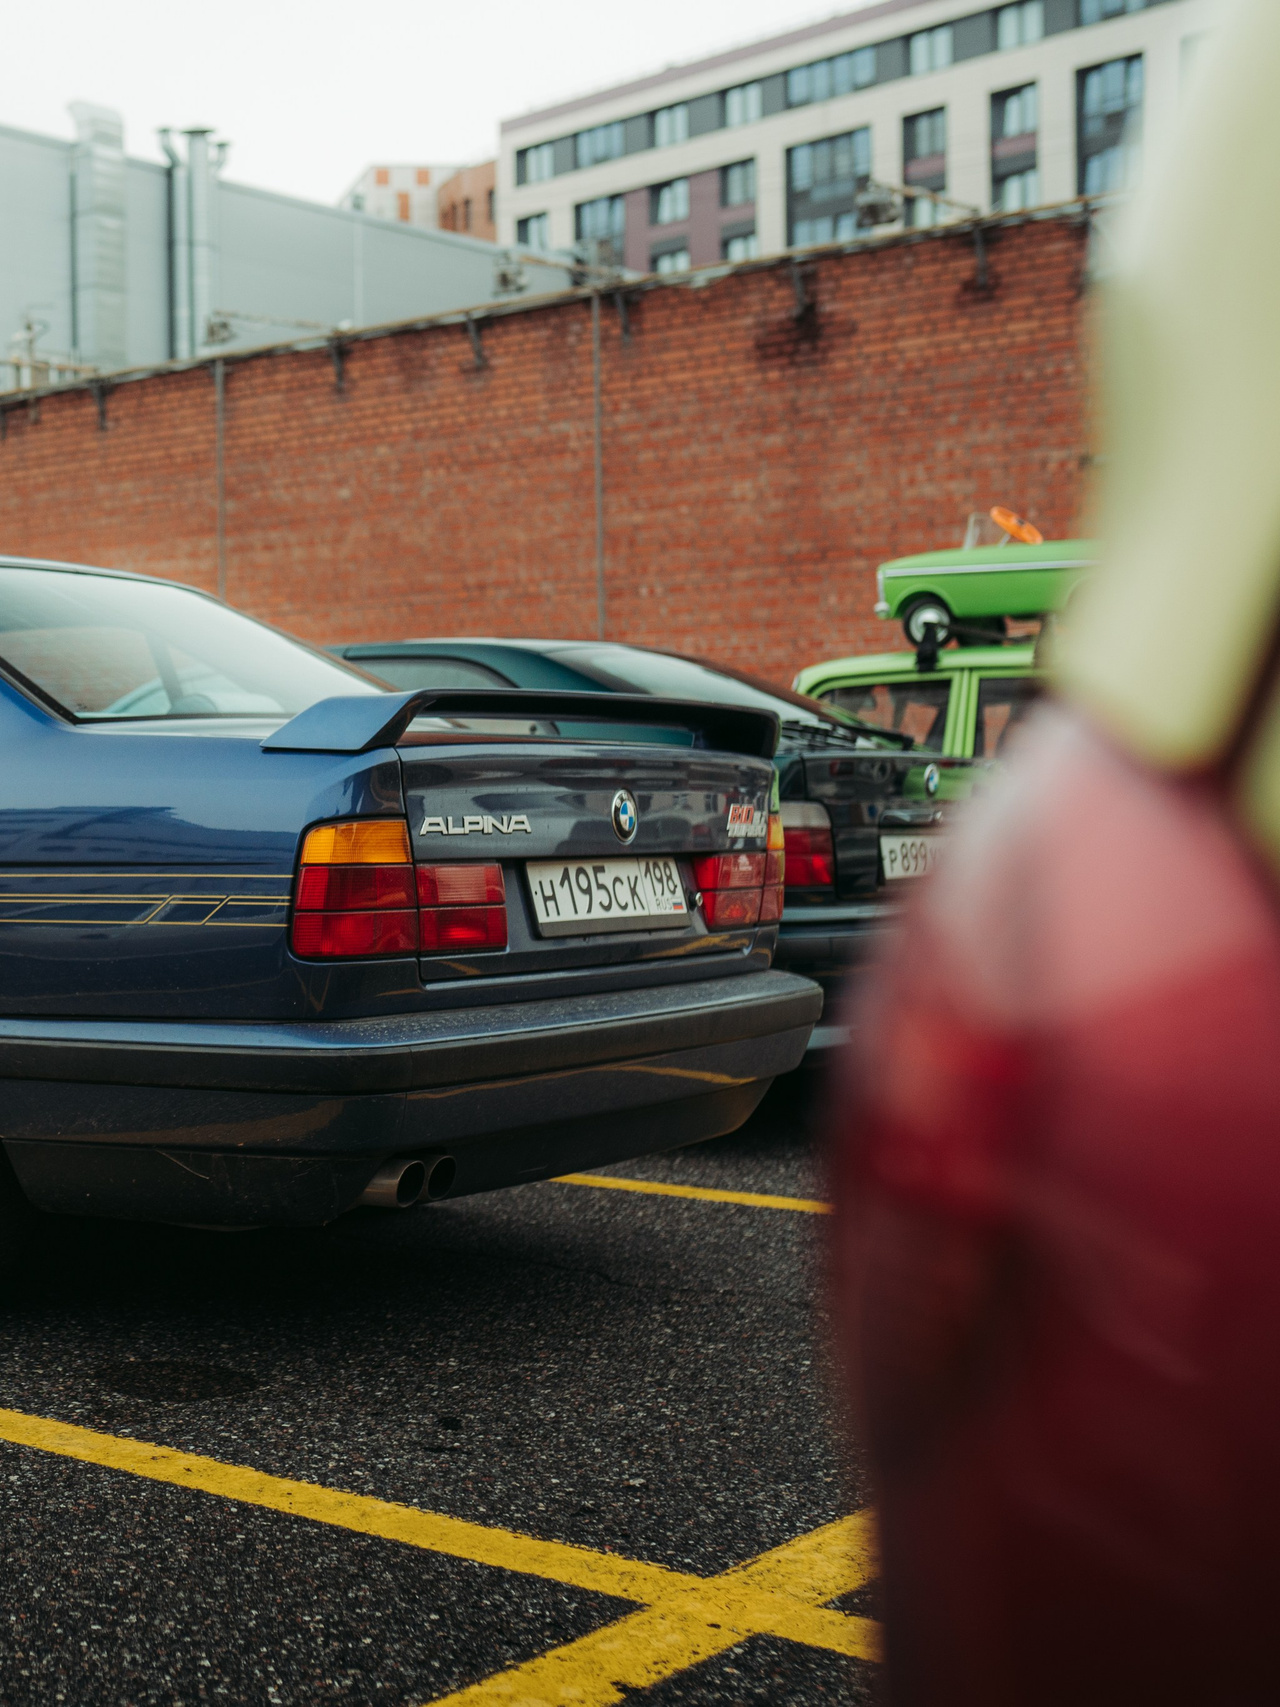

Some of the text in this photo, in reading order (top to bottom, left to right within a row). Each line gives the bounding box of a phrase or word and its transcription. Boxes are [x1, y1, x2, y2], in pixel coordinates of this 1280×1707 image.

[419, 815, 532, 836] ALPINA
[538, 860, 678, 917] H195CK 198
[656, 898, 673, 911] RUS
